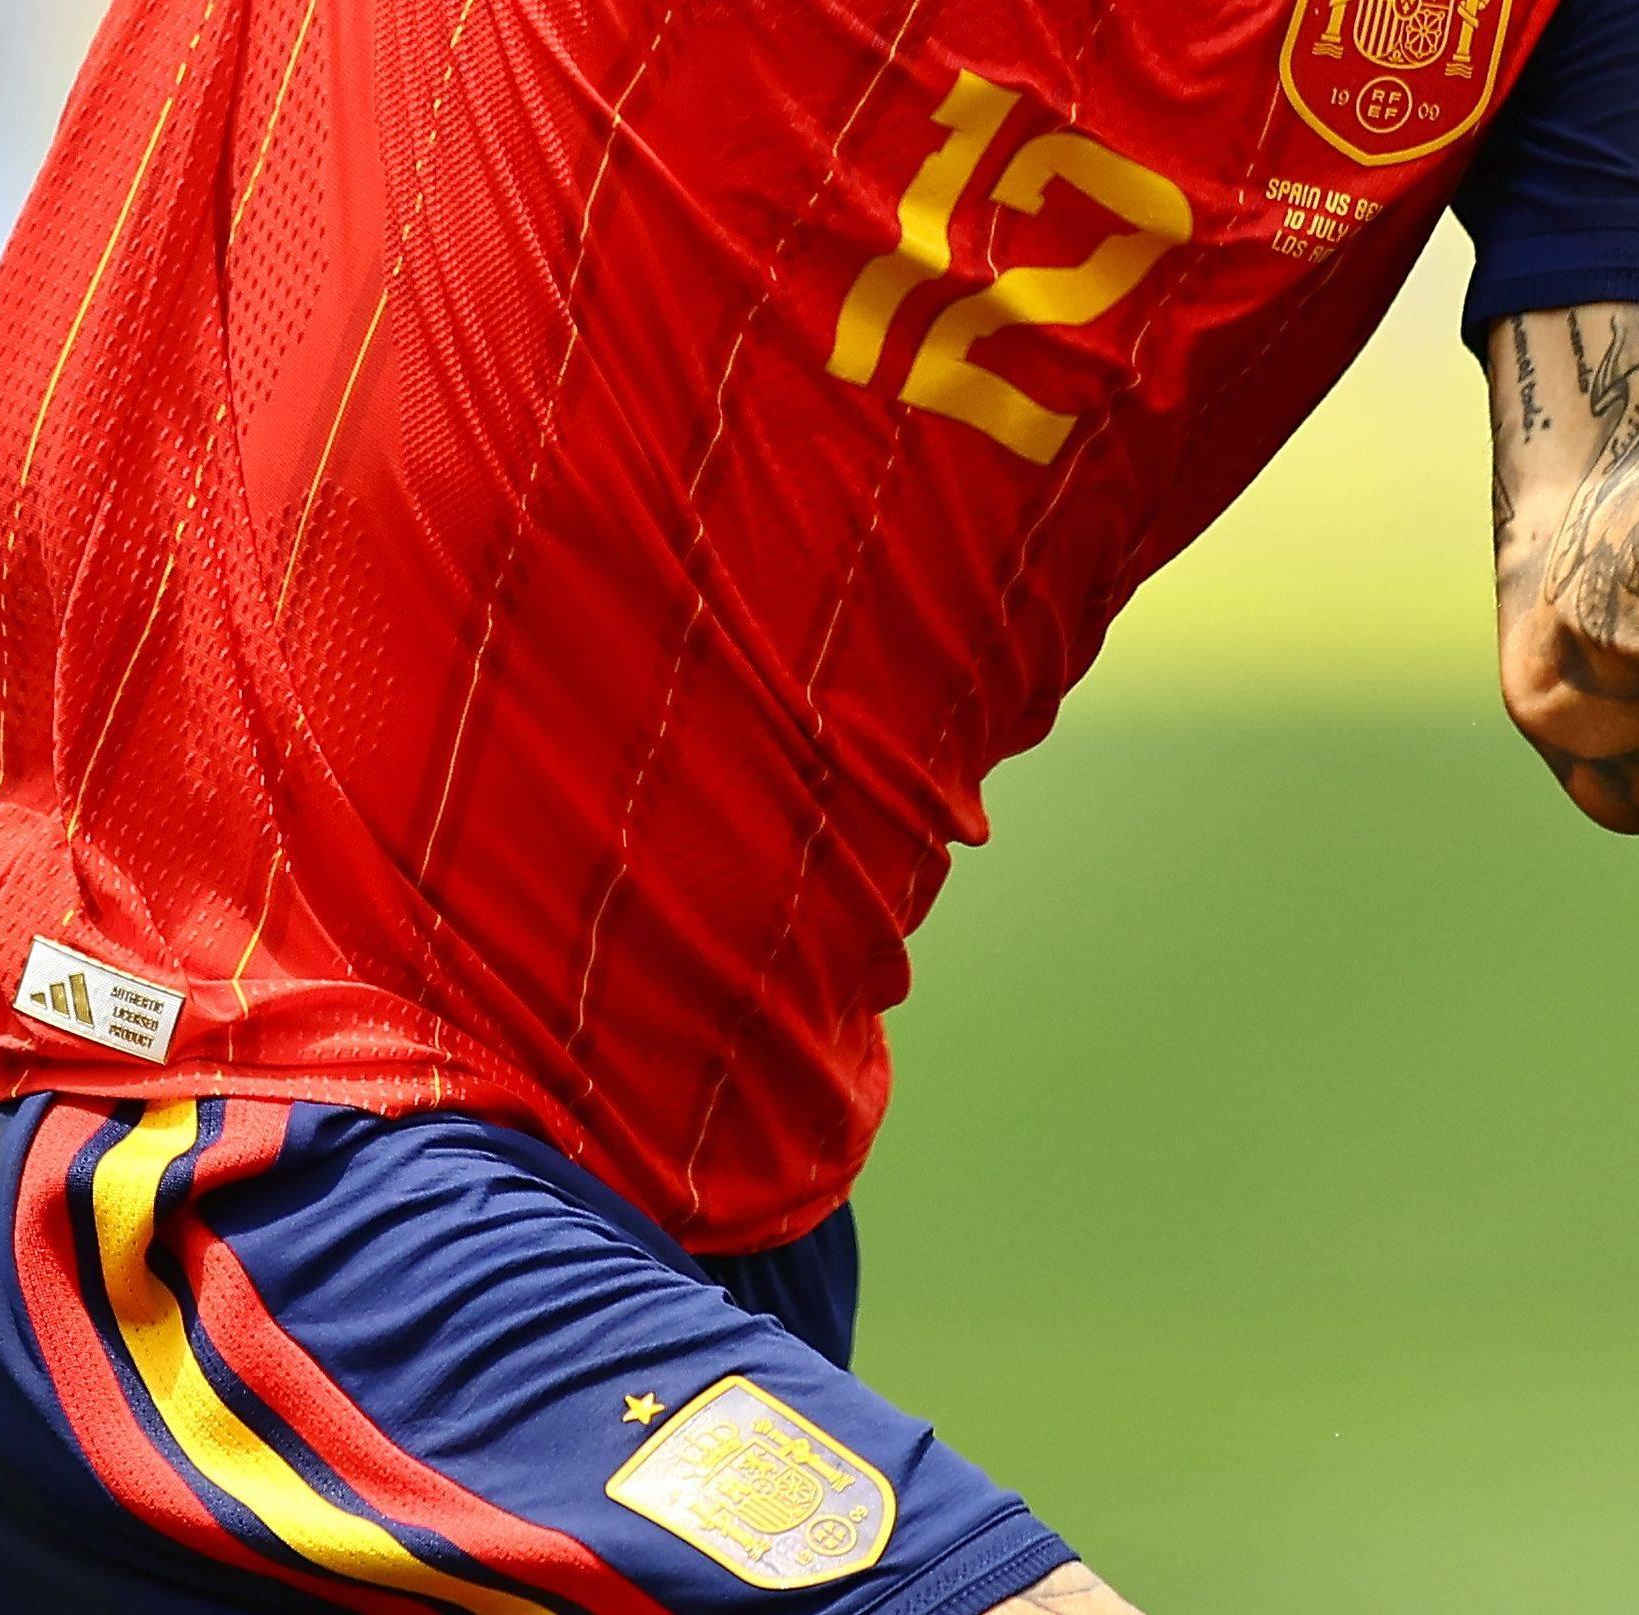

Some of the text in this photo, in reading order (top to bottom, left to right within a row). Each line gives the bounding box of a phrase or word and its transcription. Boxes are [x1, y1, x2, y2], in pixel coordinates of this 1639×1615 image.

[1330, 87, 1350, 106] 19
[1265, 177, 1321, 210] SPAIN
[1283, 207, 1349, 243] 10 JULY
[1271, 229, 1309, 258] LOS
[825, 67, 1194, 466] 12
[112, 1006, 159, 1032] LICENSED
[108, 1024, 155, 1049] PRODUCT
